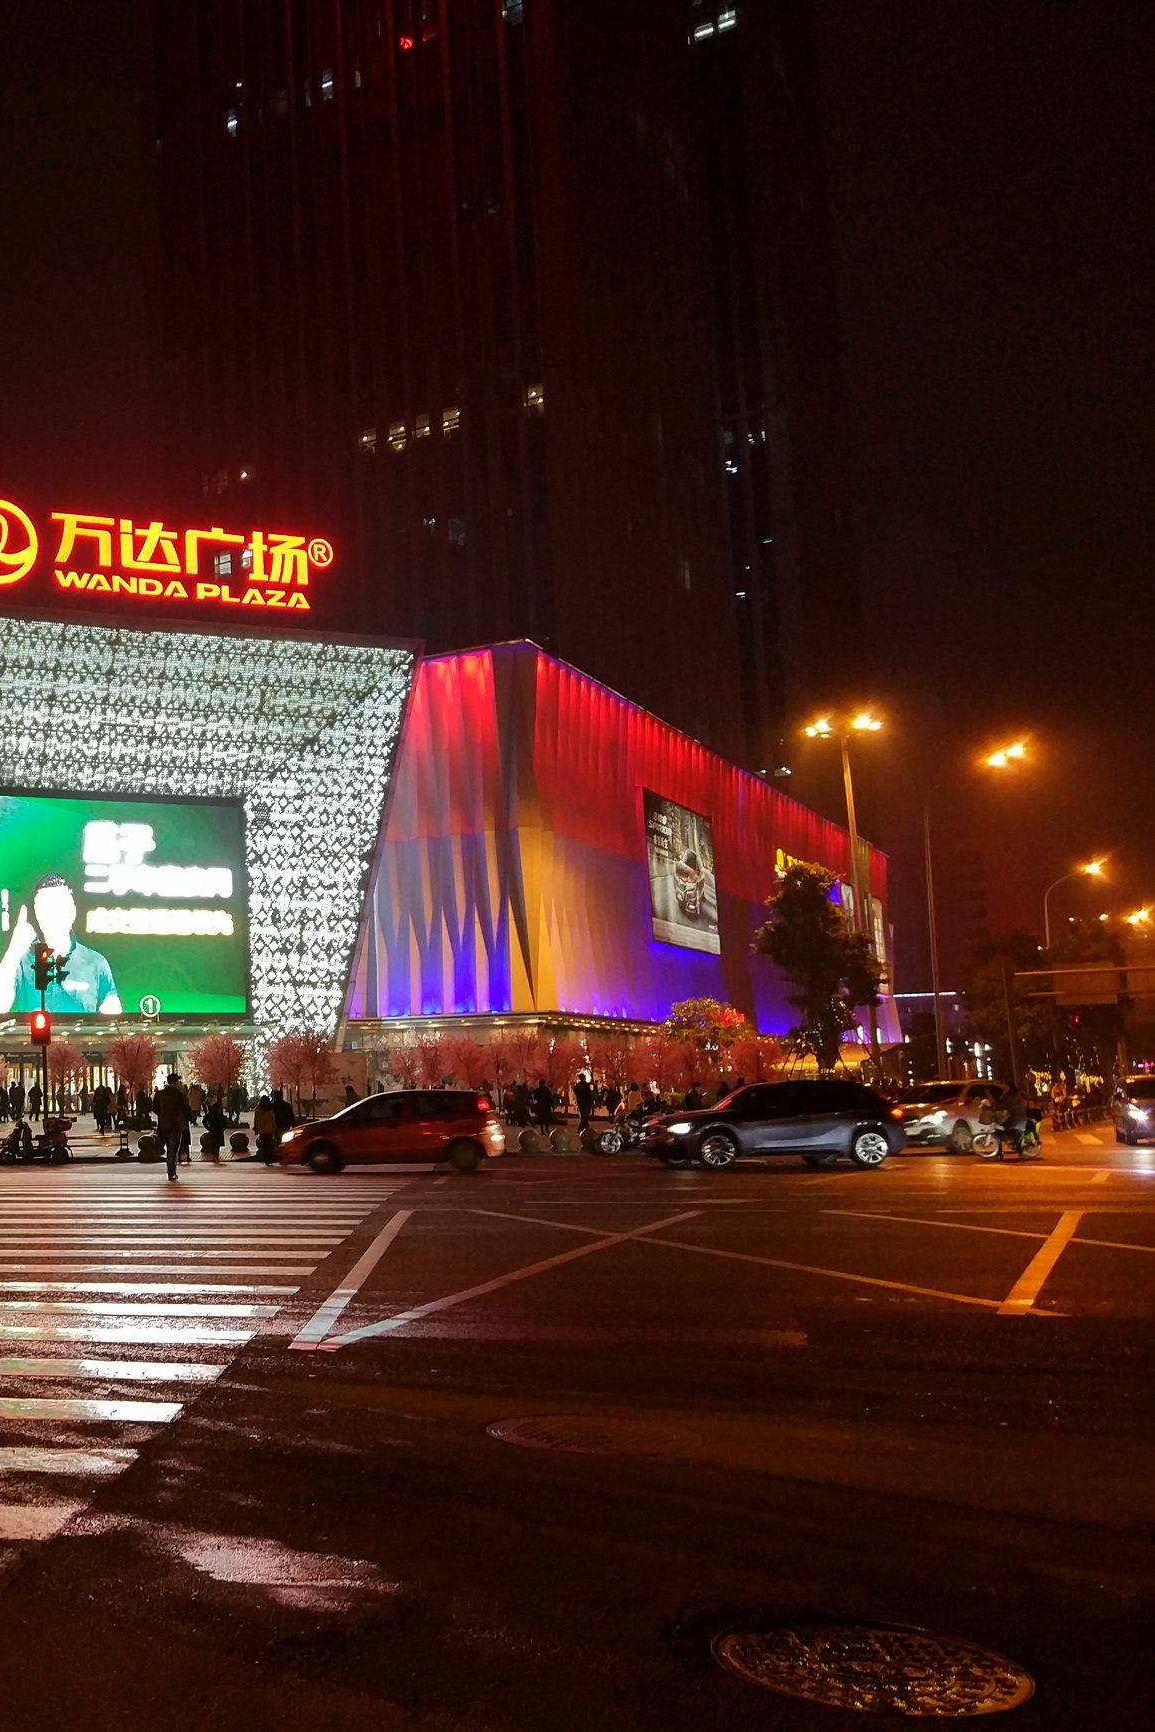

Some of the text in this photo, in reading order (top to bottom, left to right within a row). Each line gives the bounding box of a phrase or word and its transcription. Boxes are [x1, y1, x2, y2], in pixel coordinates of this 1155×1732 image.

[51, 511, 310, 586] 万达广场
[54, 569, 311, 610] WANDA PLAZA
